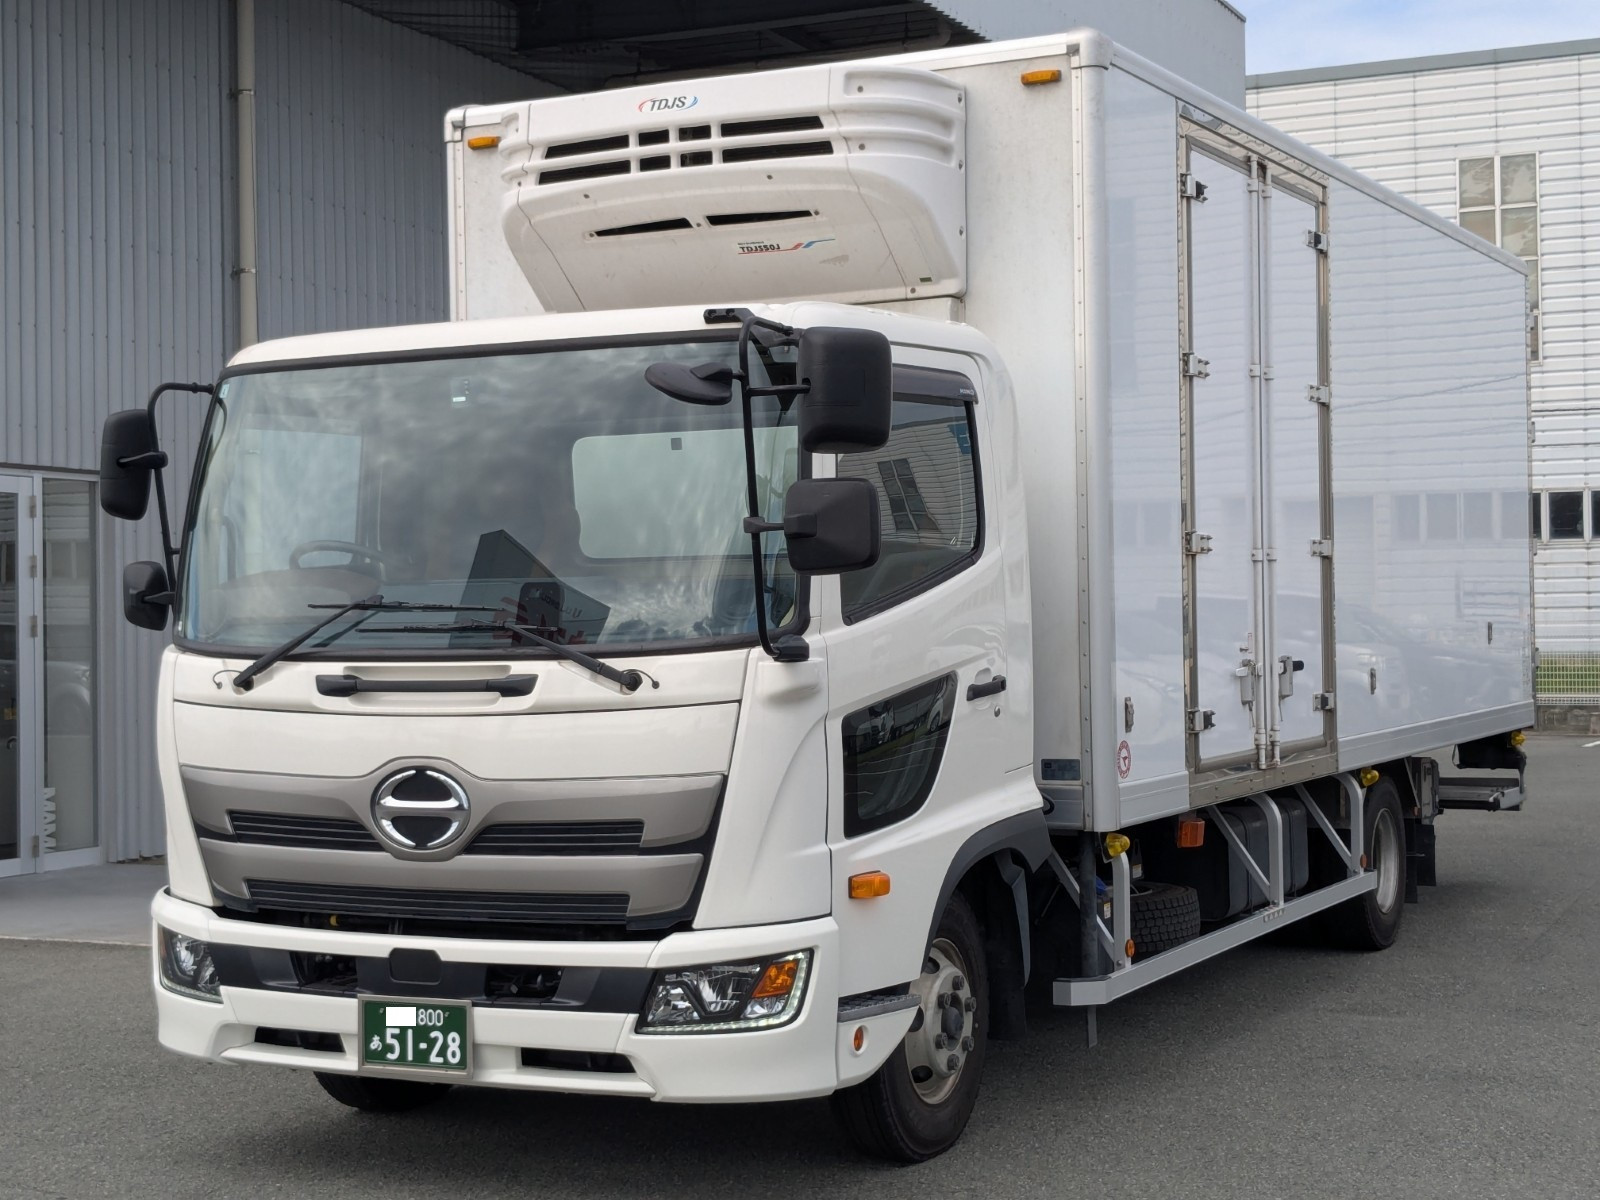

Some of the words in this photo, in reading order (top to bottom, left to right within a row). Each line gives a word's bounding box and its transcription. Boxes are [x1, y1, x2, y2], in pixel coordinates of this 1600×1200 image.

[650, 95, 687, 112] TDJS
[418, 1008, 443, 1027] 800
[370, 1034, 383, 1051] あ
[385, 1027, 461, 1064] 51-28
